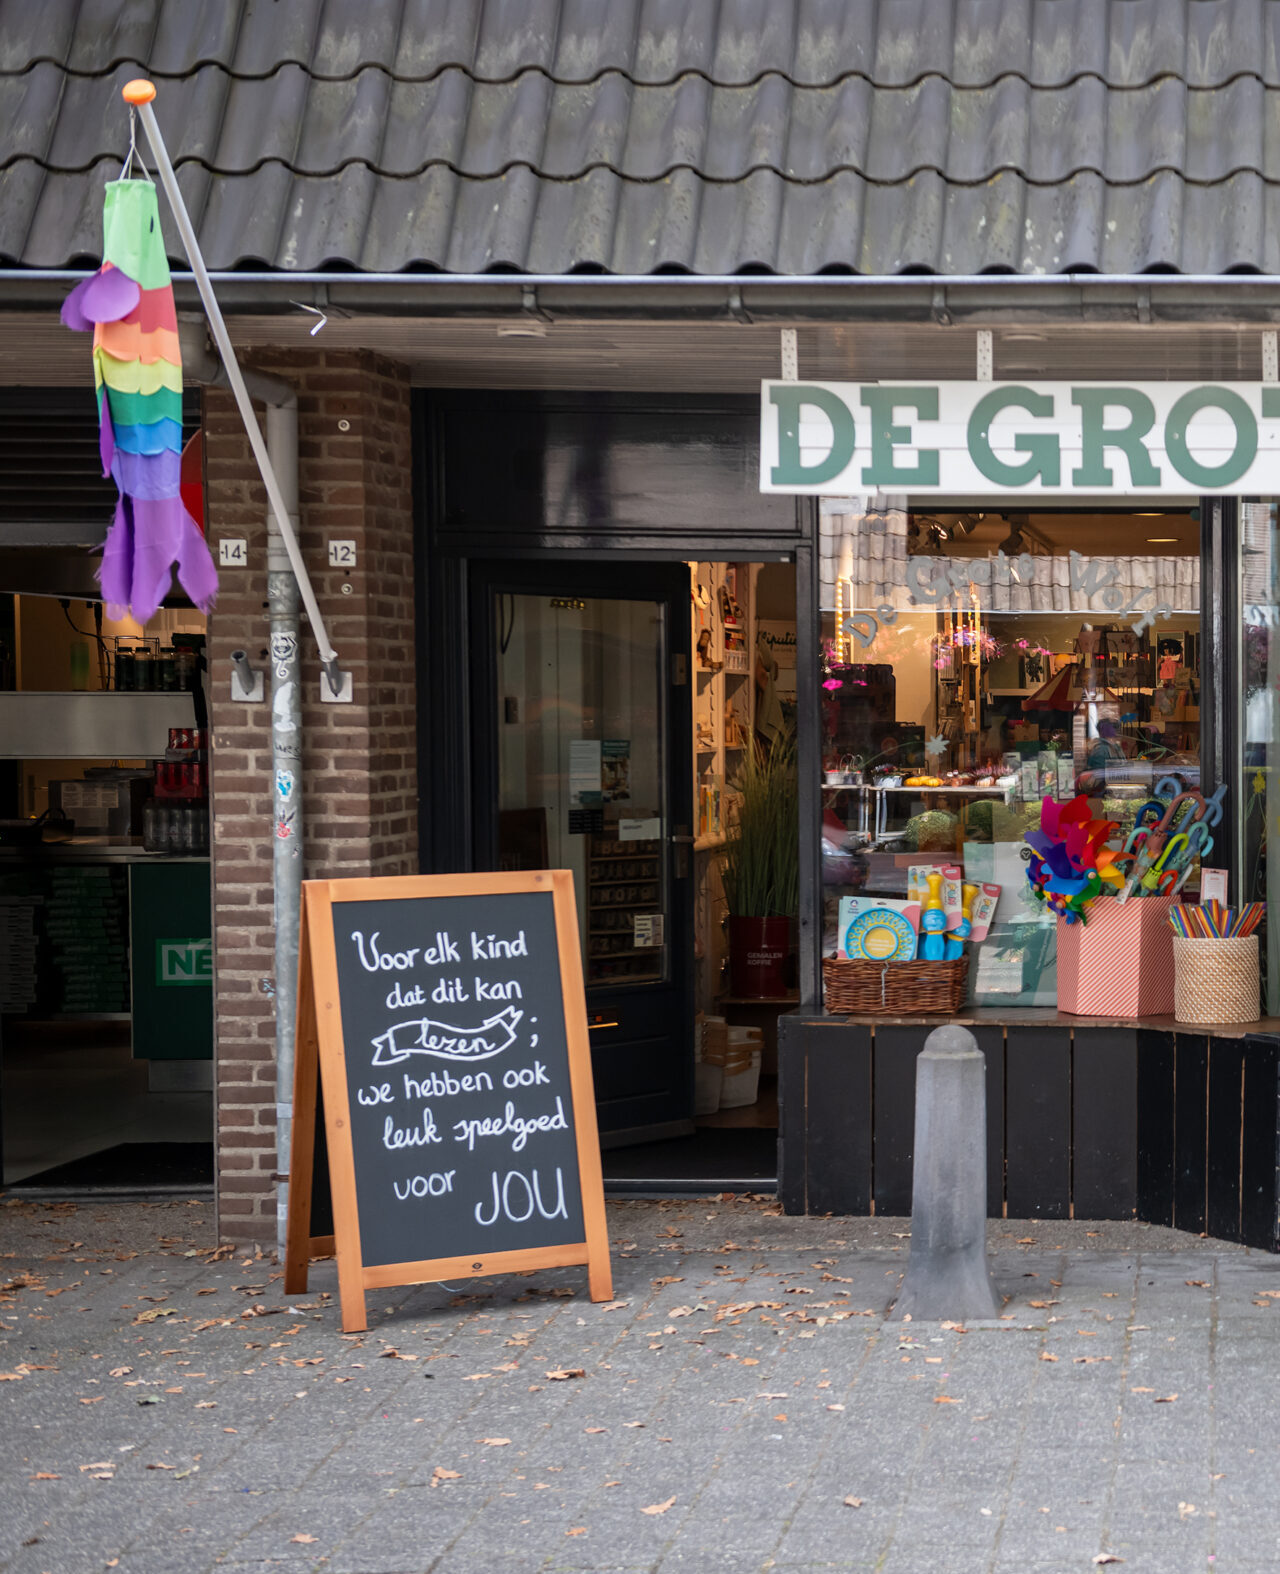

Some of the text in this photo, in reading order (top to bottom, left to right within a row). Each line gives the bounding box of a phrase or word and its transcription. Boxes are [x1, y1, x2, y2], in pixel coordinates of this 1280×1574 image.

[769, 385, 940, 487] DE
[223, 546, 243, 561] 14
[333, 546, 351, 562] 12
[842, 549, 1174, 649] De Grote Wolf
[351, 930, 529, 972] Voor elk kind
[385, 977, 523, 1009] dat dit kan
[415, 1017, 497, 1054] lezen
[357, 1060, 551, 1106] we hebben ook
[382, 1096, 569, 1152] leuk speelgoed
[393, 1167, 569, 1226] voor JOU
